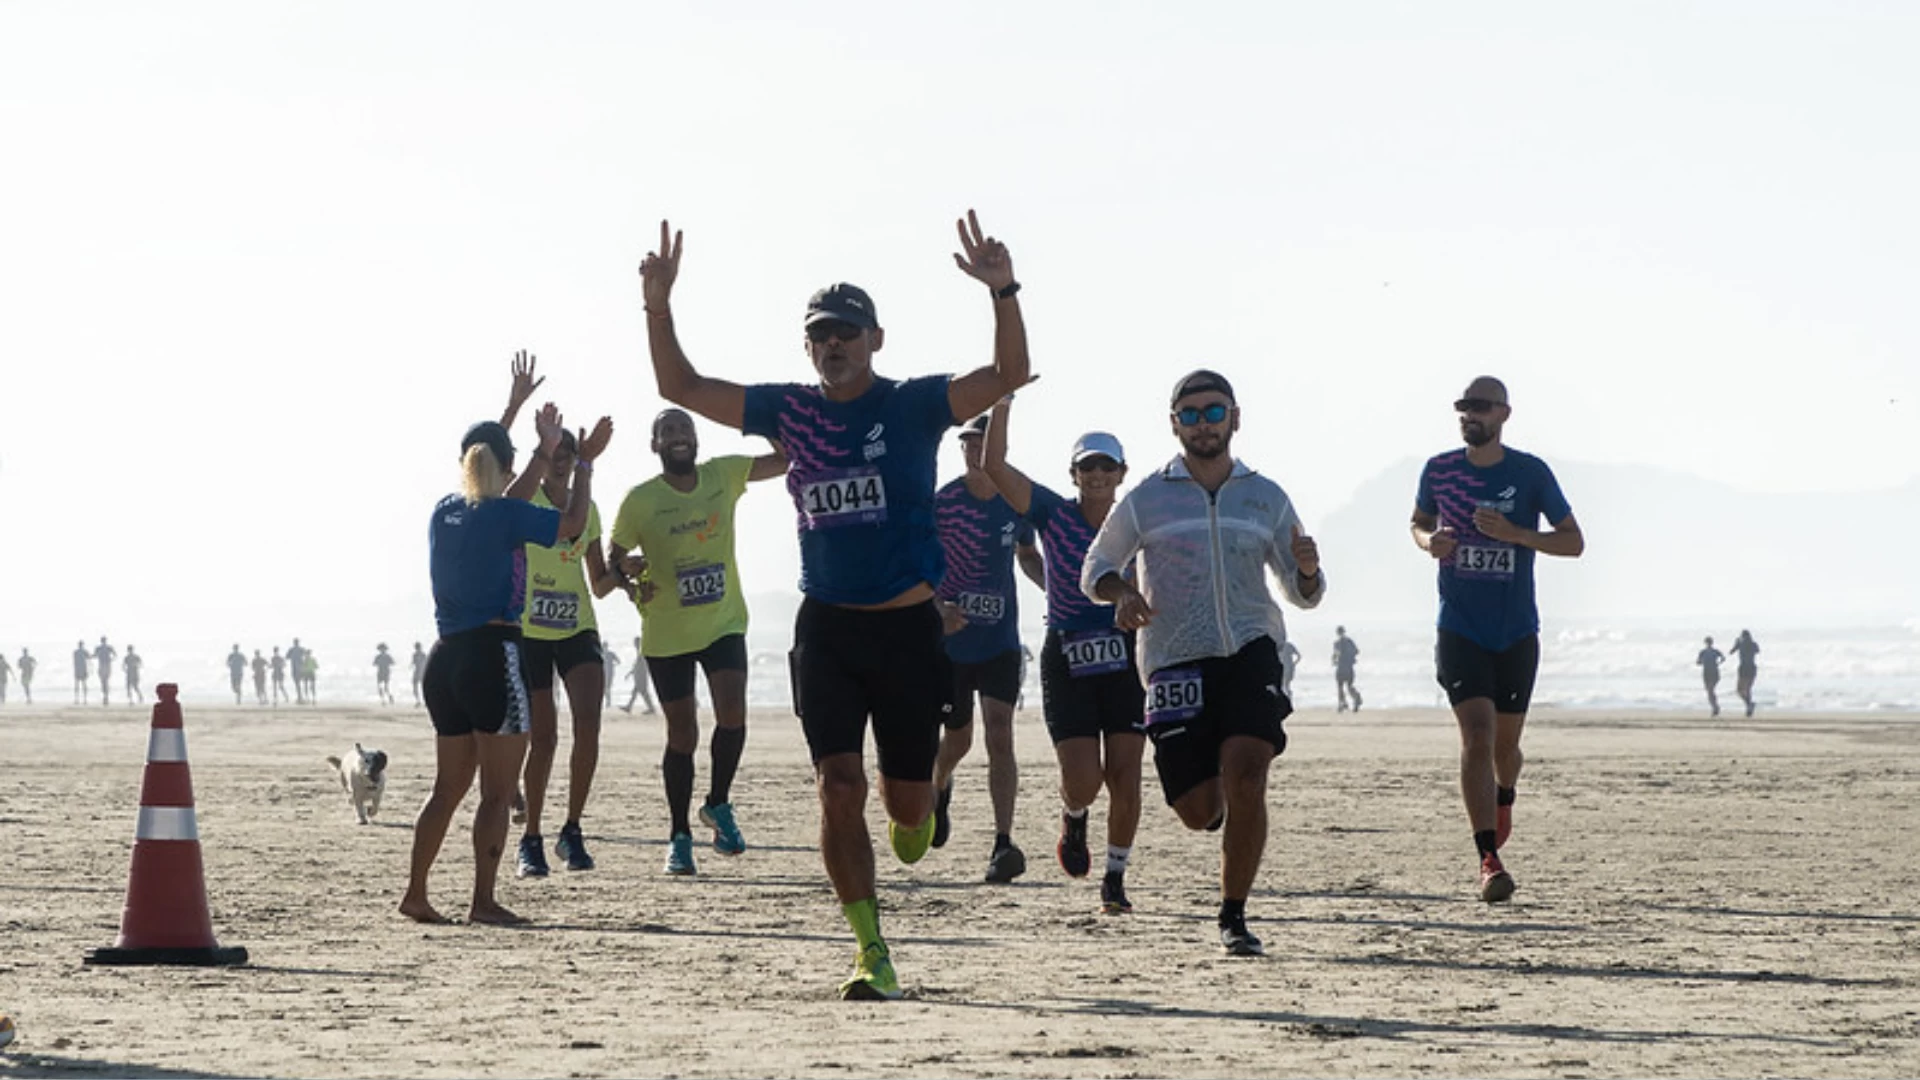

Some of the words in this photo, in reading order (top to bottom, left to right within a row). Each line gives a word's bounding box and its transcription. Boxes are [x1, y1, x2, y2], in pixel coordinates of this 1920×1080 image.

[809, 478, 880, 513] 1044
[1461, 547, 1510, 570] 1374
[535, 600, 577, 619] 1022
[961, 594, 1001, 617] 1493
[1068, 639, 1121, 665] 1070
[1148, 681, 1198, 710] 850
